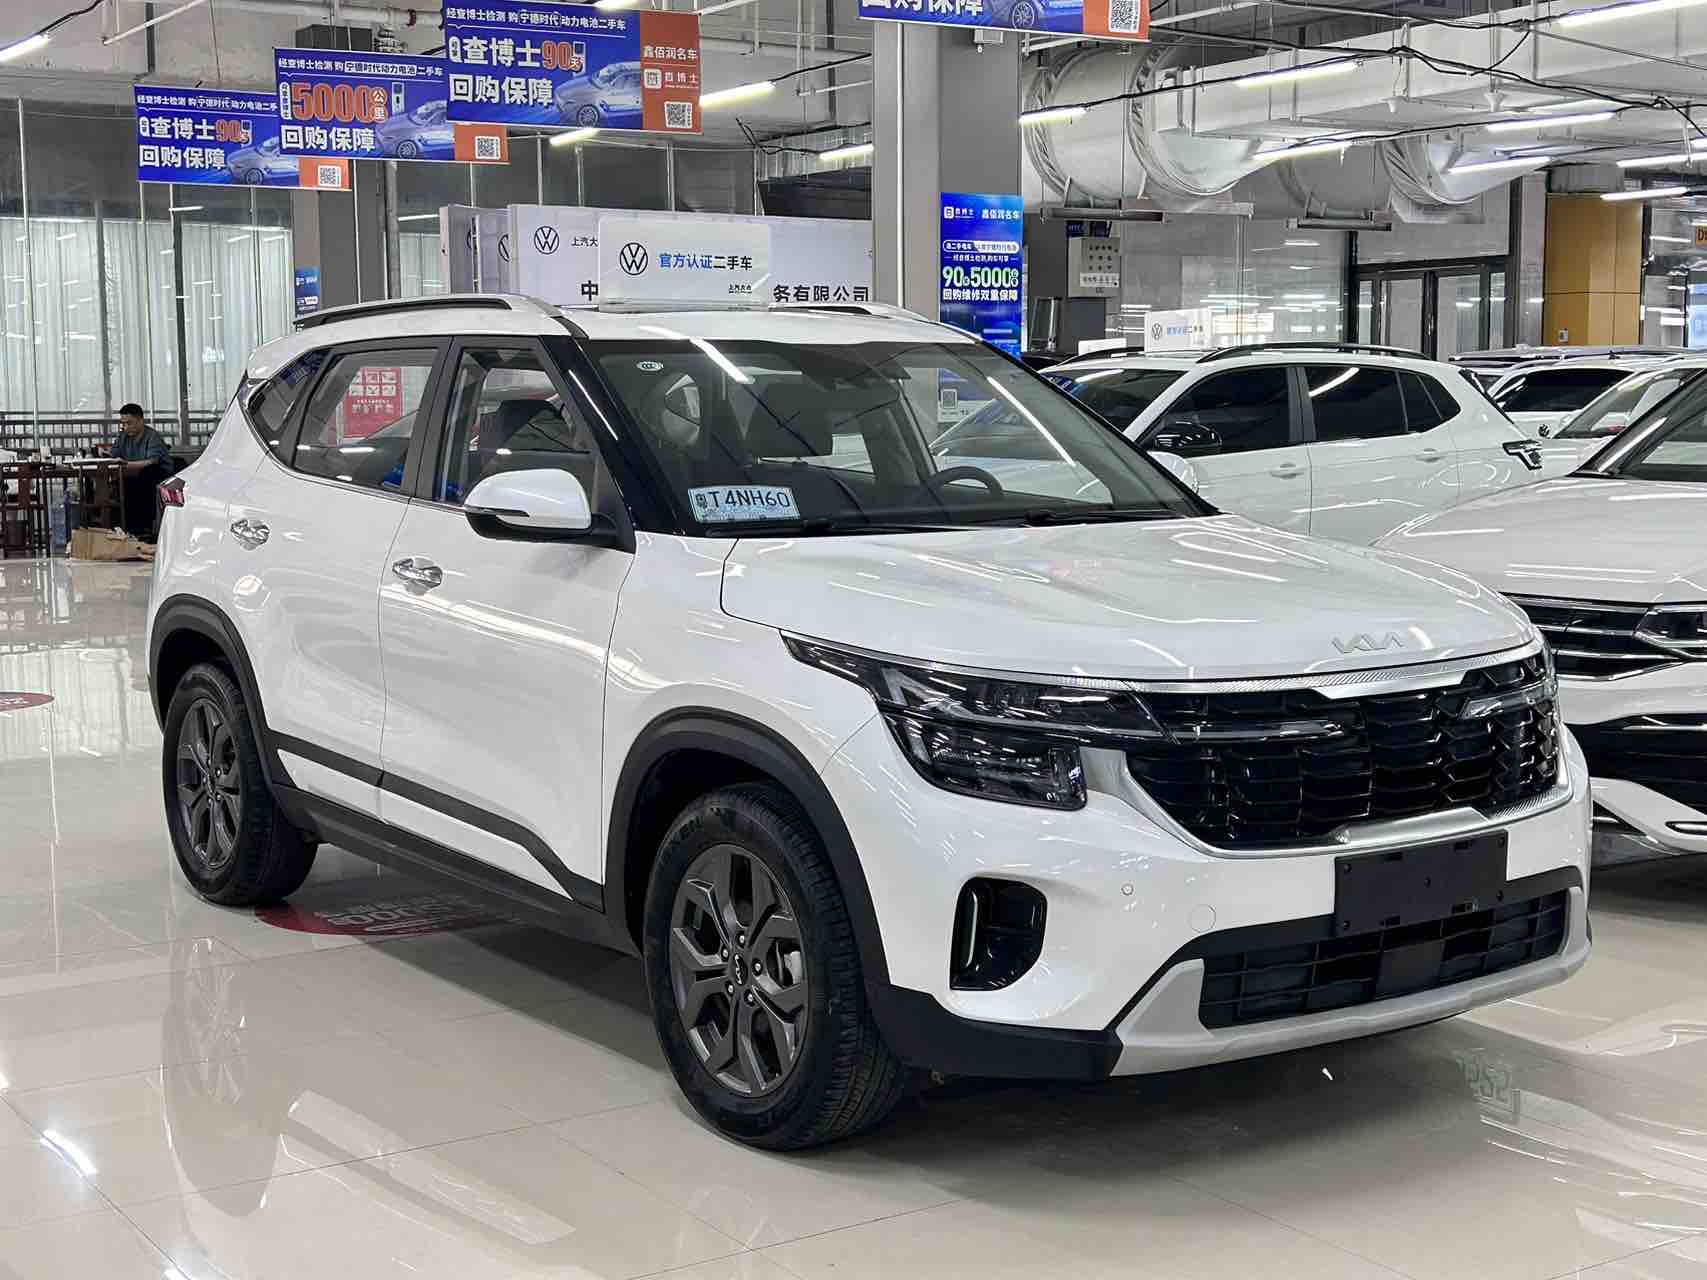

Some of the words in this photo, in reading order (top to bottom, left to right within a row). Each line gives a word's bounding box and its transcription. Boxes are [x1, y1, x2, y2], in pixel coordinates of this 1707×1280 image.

[449, 73, 553, 107] 回购保障
[281, 125, 376, 153] 回购保障
[138, 144, 226, 170] 回购保障
[659, 253, 753, 271] 官方认证二手车
[580, 280, 599, 302] 中
[773, 285, 870, 303] 务有限公司
